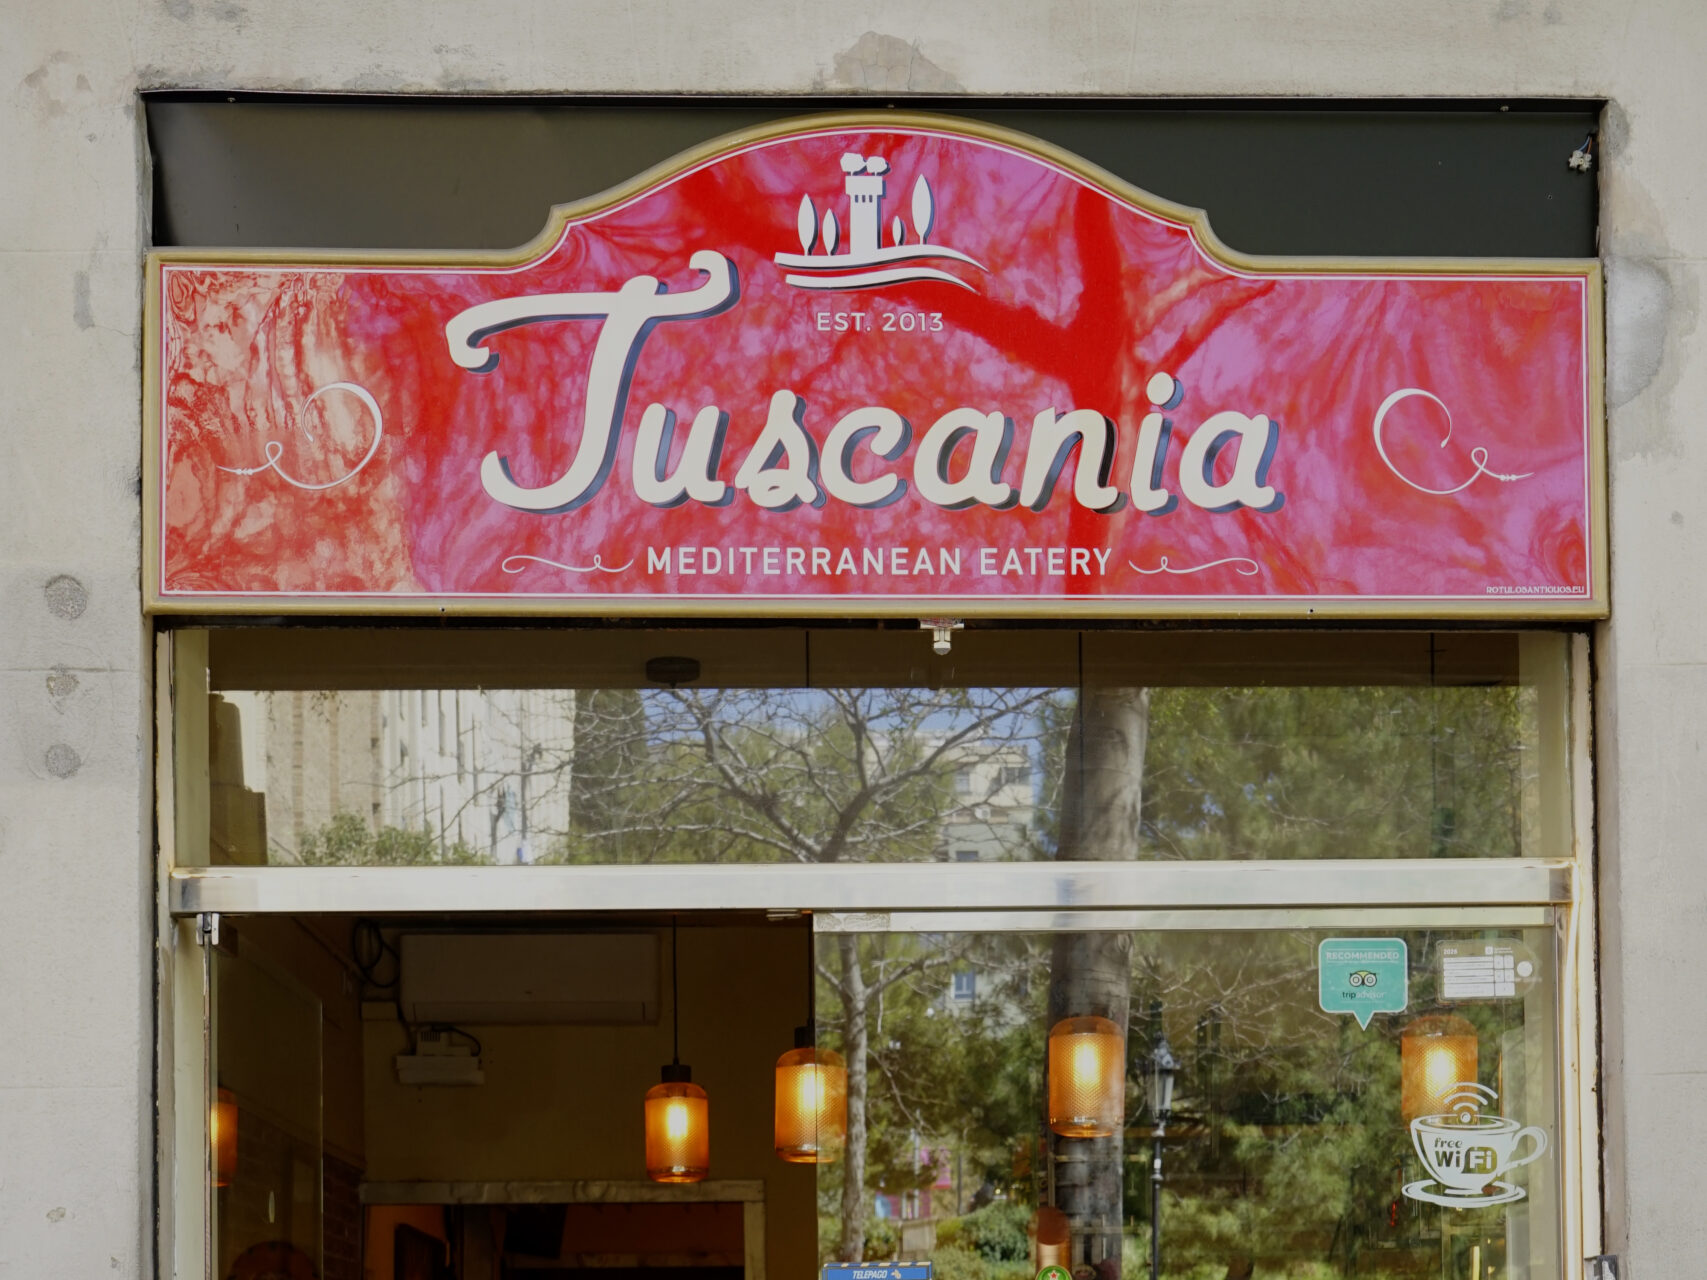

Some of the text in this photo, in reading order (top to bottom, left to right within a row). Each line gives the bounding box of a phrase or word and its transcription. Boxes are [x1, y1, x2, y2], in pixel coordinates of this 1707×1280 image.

[816, 311, 945, 333] EST. 2013
[445, 249, 1286, 516] Tuscania
[646, 546, 1113, 577] MEDITERRANEAN EATERY
[1326, 950, 1400, 961] RECOMMENDED
[1341, 991, 1385, 1000] tripadvisor
[1434, 1137, 1463, 1149] free
[852, 1269, 888, 1280] TELEPAGO
